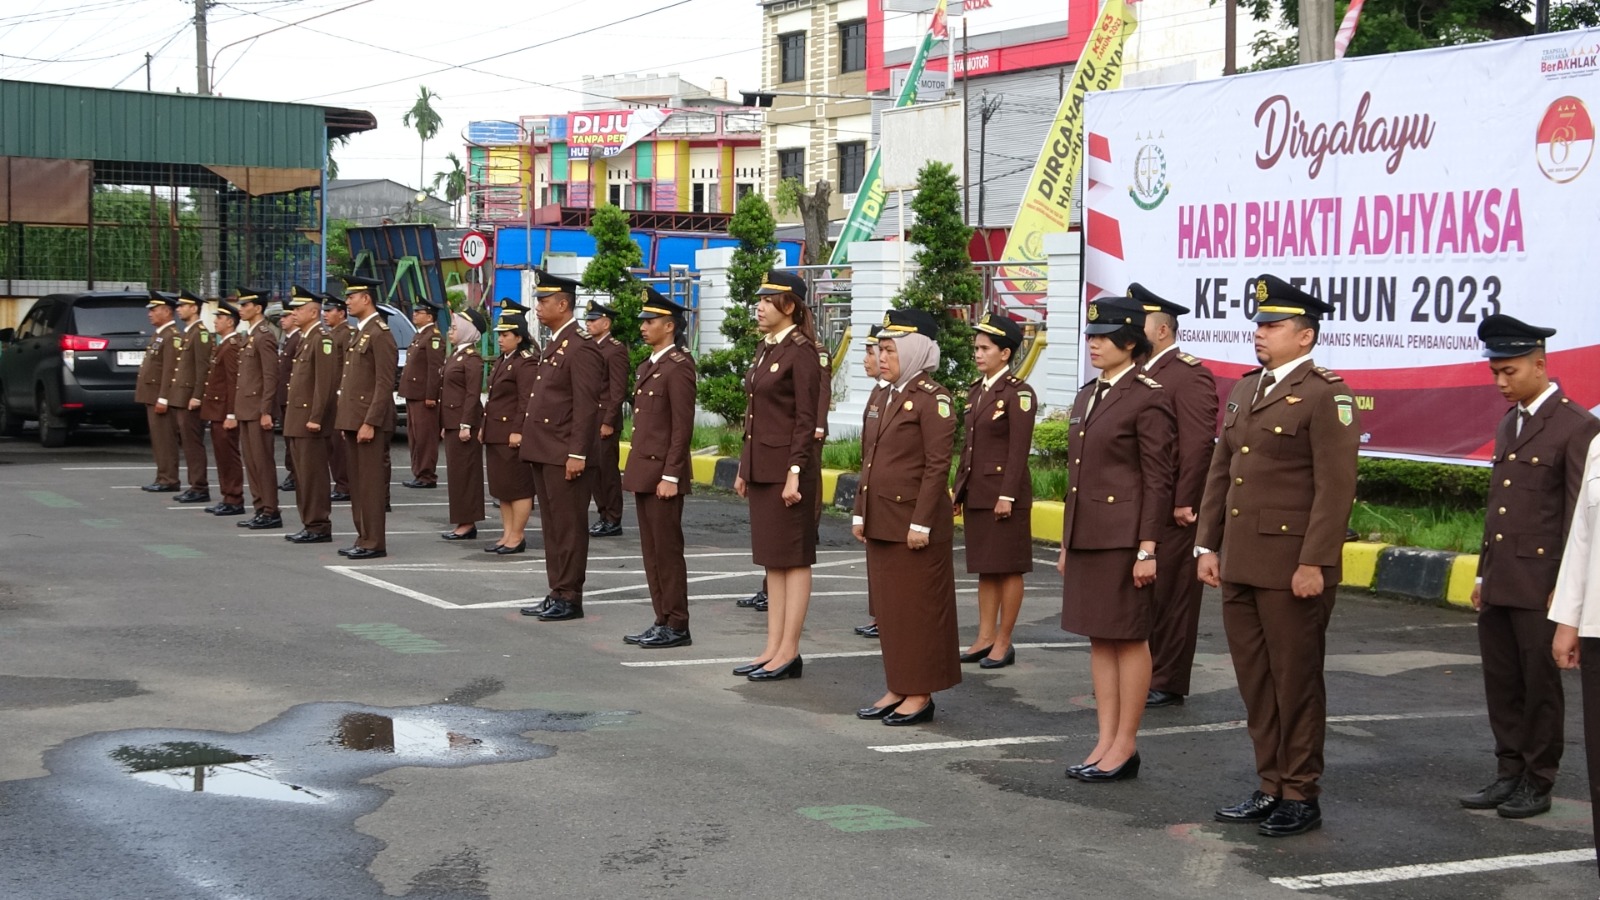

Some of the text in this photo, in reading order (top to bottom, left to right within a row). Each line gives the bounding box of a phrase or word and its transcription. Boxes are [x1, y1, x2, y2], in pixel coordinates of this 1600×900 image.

[1541, 55, 1597, 73] BerAKHLAK
[921, 80, 946, 89] MOTOR
[572, 134, 604, 144] TANPA
[1038, 59, 1096, 200] DIRGAHAYU
[1254, 91, 1436, 180] Dirgahayu
[1178, 188, 1525, 259] HARI BHAKTI ADHYAKSA
[463, 240, 477, 258] 40
[1195, 277, 1257, 320] KE-6
[1410, 275, 1502, 323] 2023
[1212, 330, 1240, 343] HUKUM
[1353, 334, 1404, 349] MENGAWAL
[1407, 335, 1480, 350] PEMBANGUNAN
